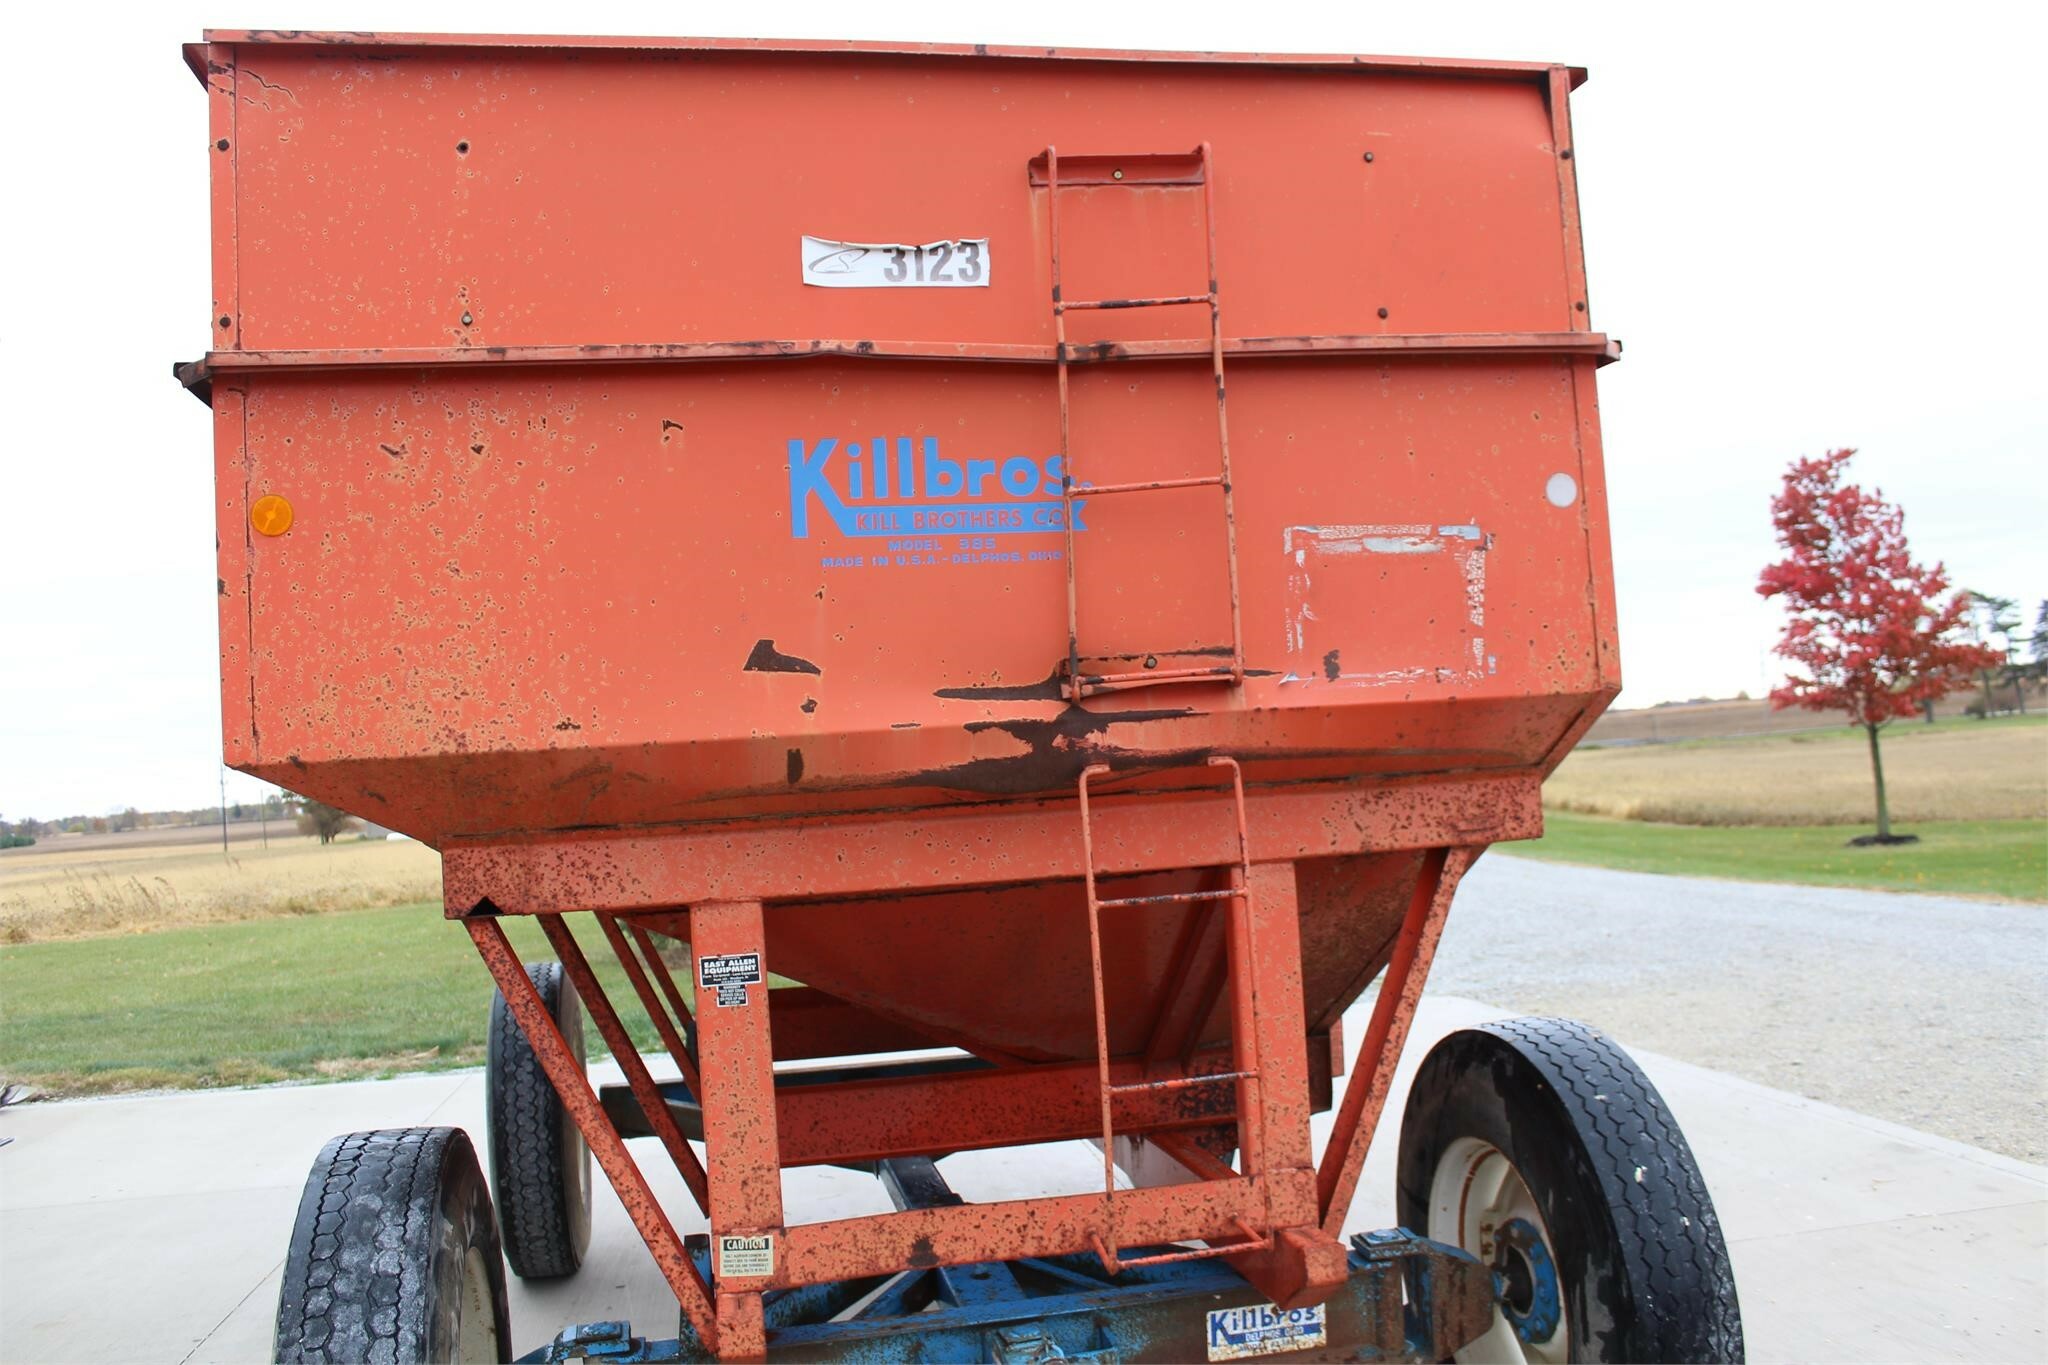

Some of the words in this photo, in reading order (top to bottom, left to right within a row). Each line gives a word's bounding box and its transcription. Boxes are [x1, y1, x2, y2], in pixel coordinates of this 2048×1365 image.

[883, 243, 982, 282] 3123
[856, 513, 901, 531] KILL
[913, 510, 1023, 530] BROTHERS
[888, 539, 943, 552] MODEL
[821, 556, 863, 568] MADE
[872, 556, 889, 567] IN
[704, 960, 726, 968] EAST
[728, 958, 756, 966] ALLEN
[704, 965, 757, 975] EQUIPMENT
[726, 1239, 766, 1250] CAUTION
